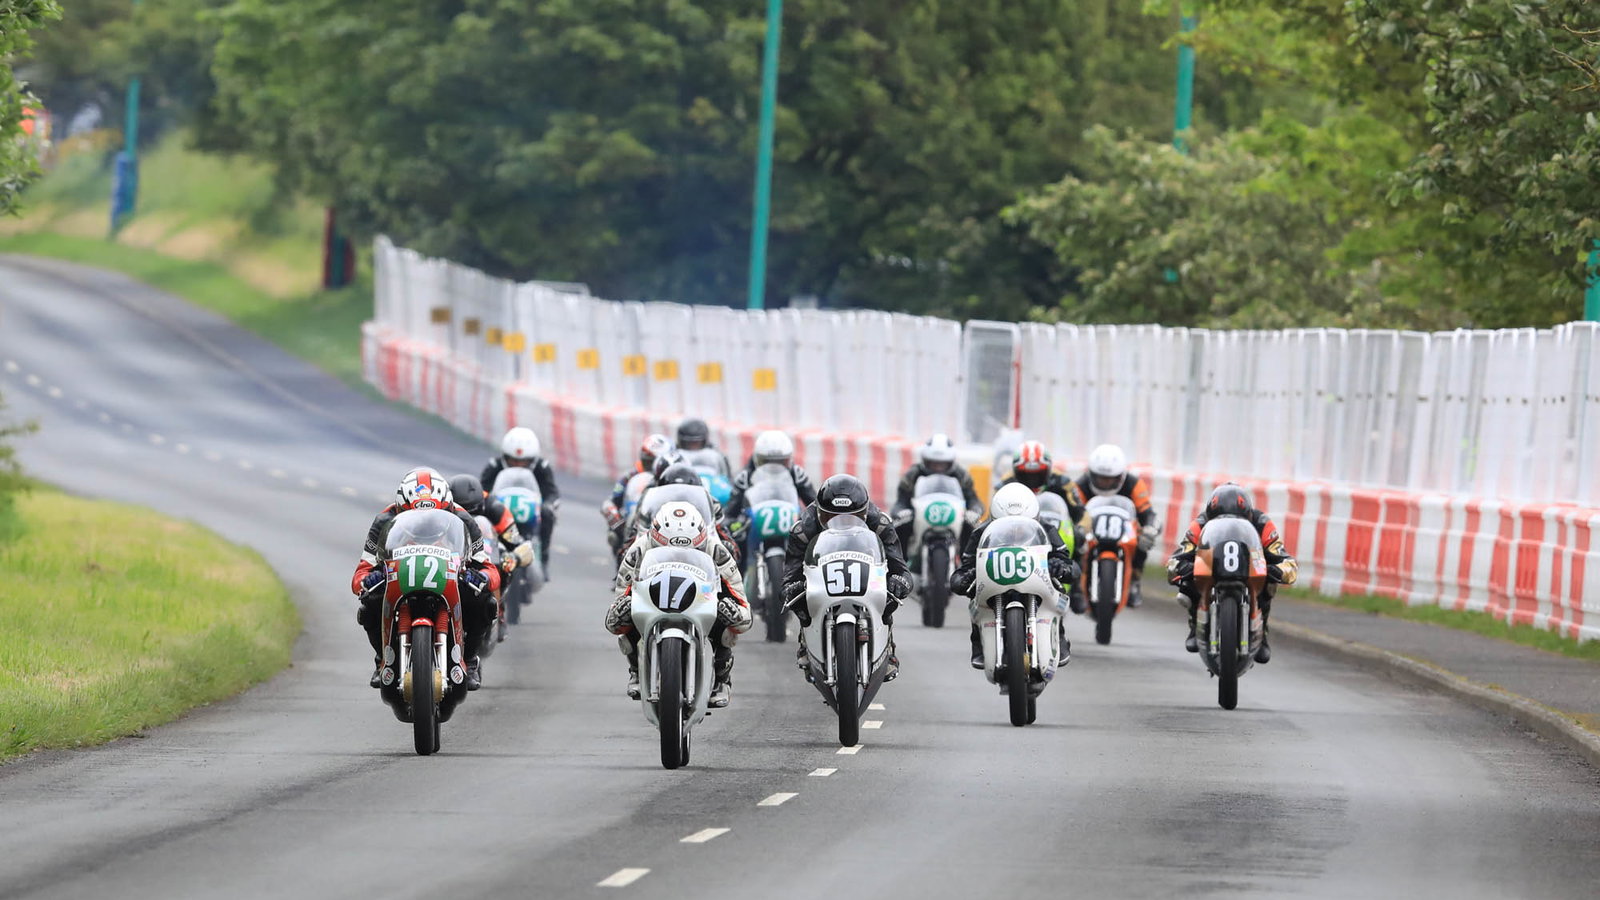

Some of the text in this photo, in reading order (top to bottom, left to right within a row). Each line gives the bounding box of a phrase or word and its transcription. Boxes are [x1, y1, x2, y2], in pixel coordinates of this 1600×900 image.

[414, 500, 436, 509] Arai
[834, 498, 850, 506] SHOEI
[928, 503, 952, 525] 87
[759, 507, 791, 537] 28
[1095, 514, 1123, 541] 48
[393, 545, 450, 558] BLACKFORDS
[670, 537, 691, 545] Arai
[819, 551, 874, 565] BLACKFORDS
[992, 550, 1032, 580] 103
[1223, 540, 1239, 573] 8
[406, 555, 439, 588] 12
[648, 562, 706, 579] BLACKFORDS
[826, 561, 862, 595] 51
[651, 570, 695, 610] 17
